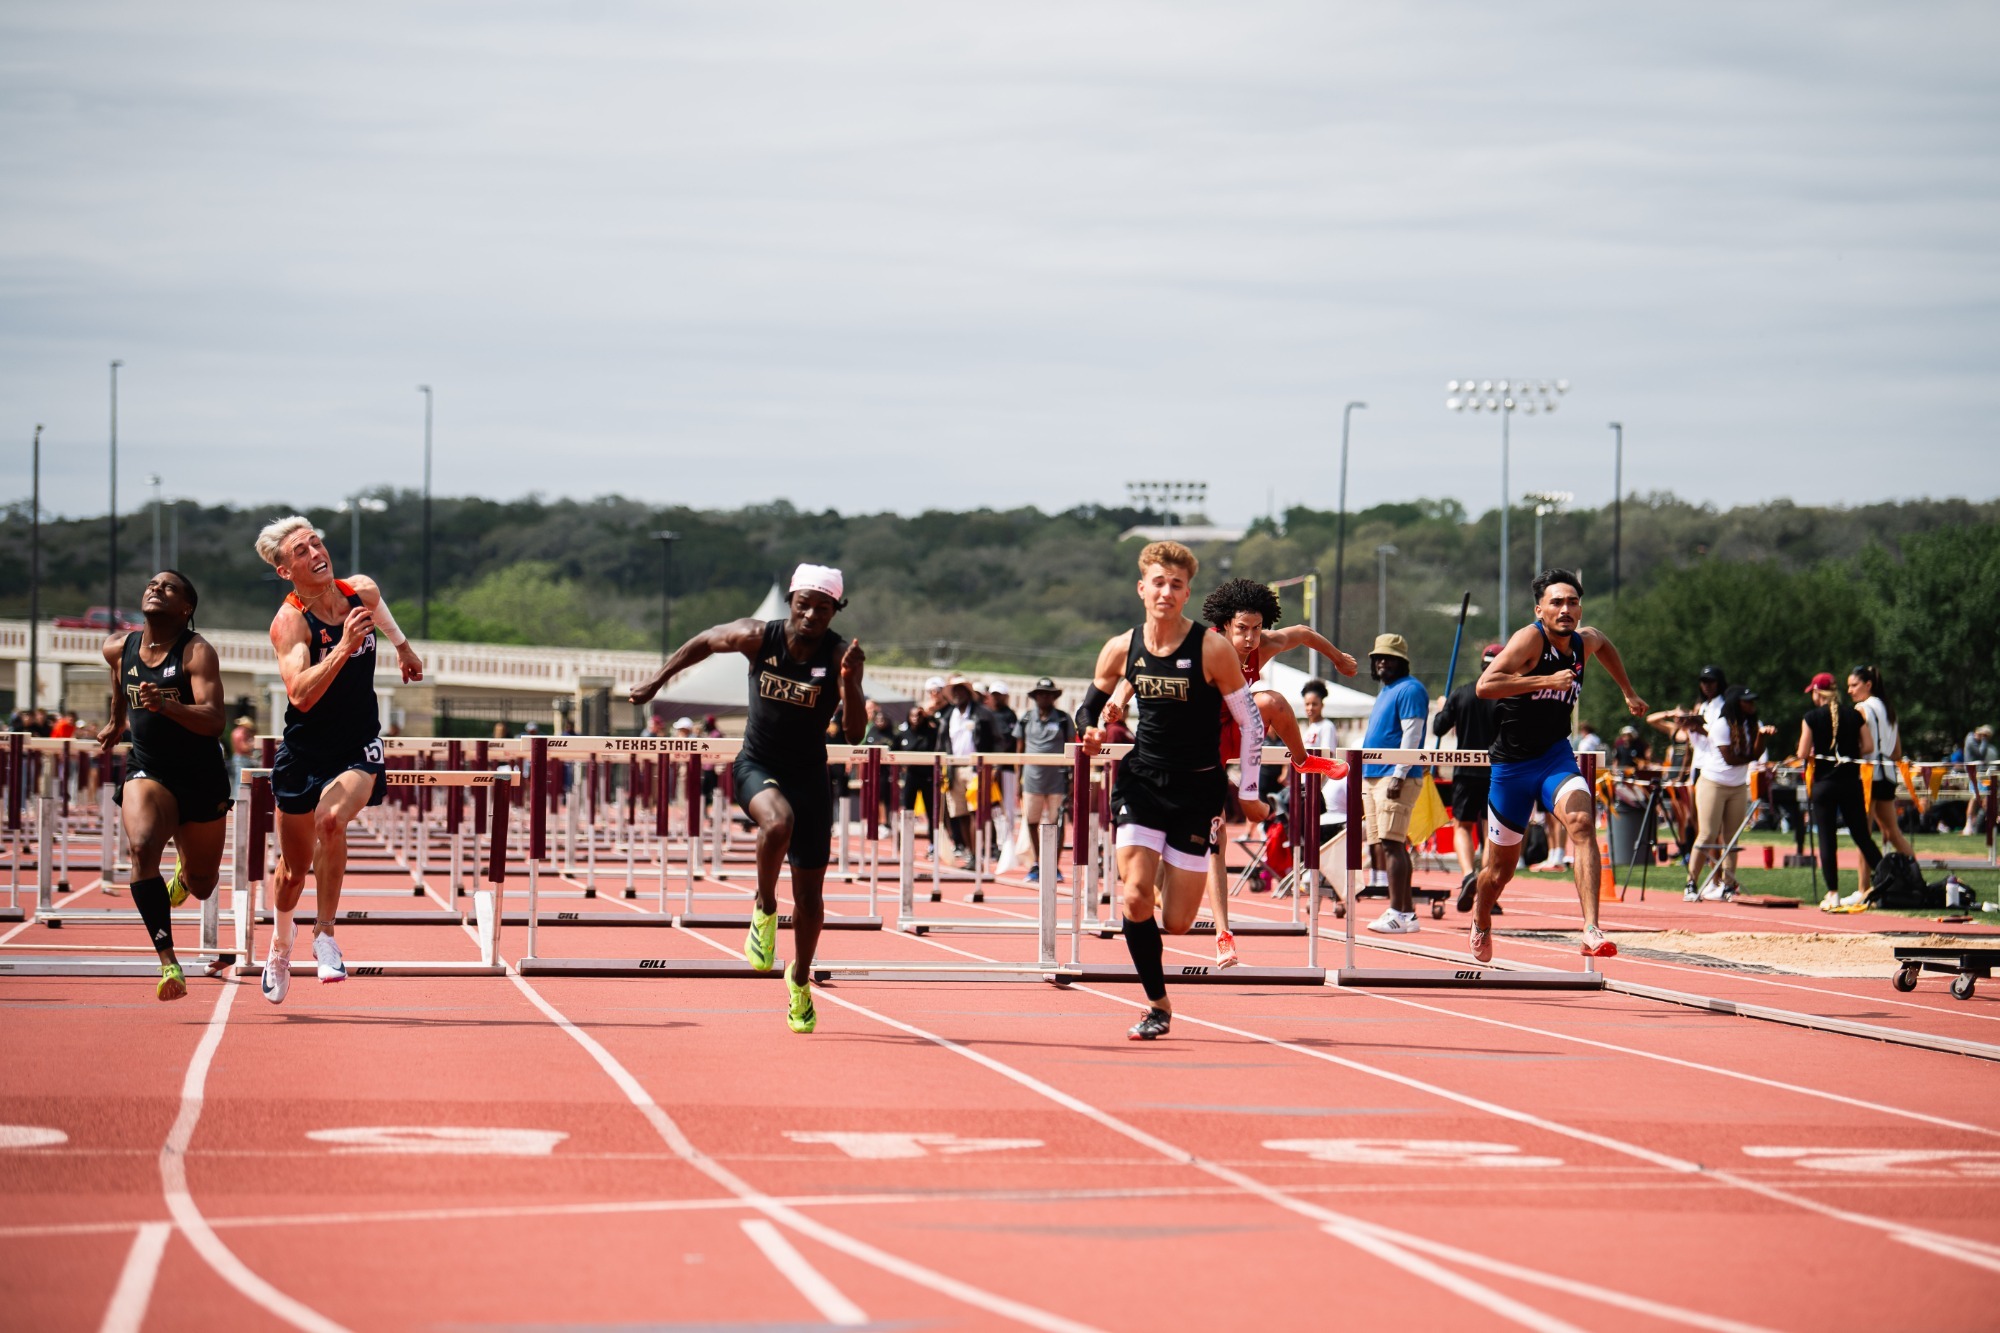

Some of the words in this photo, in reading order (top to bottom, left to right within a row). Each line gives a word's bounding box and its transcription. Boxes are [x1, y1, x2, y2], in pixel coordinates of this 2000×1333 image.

[760, 670, 821, 708] TXST
[1135, 674, 1190, 702] TXST
[547, 740, 568, 748] GILL
[615, 740, 657, 751] TEXAS
[660, 740, 698, 751] STATE
[367, 738, 383, 763] 5
[1362, 752, 1383, 760] GILL
[1430, 752, 1471, 763] TEXAS
[386, 774, 425, 784] STATE
[346, 911, 369, 919] GILL
[557, 912, 580, 920] GILL
[1194, 921, 1216, 929] GILL
[639, 959, 667, 968] GILL
[356, 967, 384, 975] GILL
[1181, 966, 1209, 975] GILL
[1454, 970, 1482, 980] GILL
